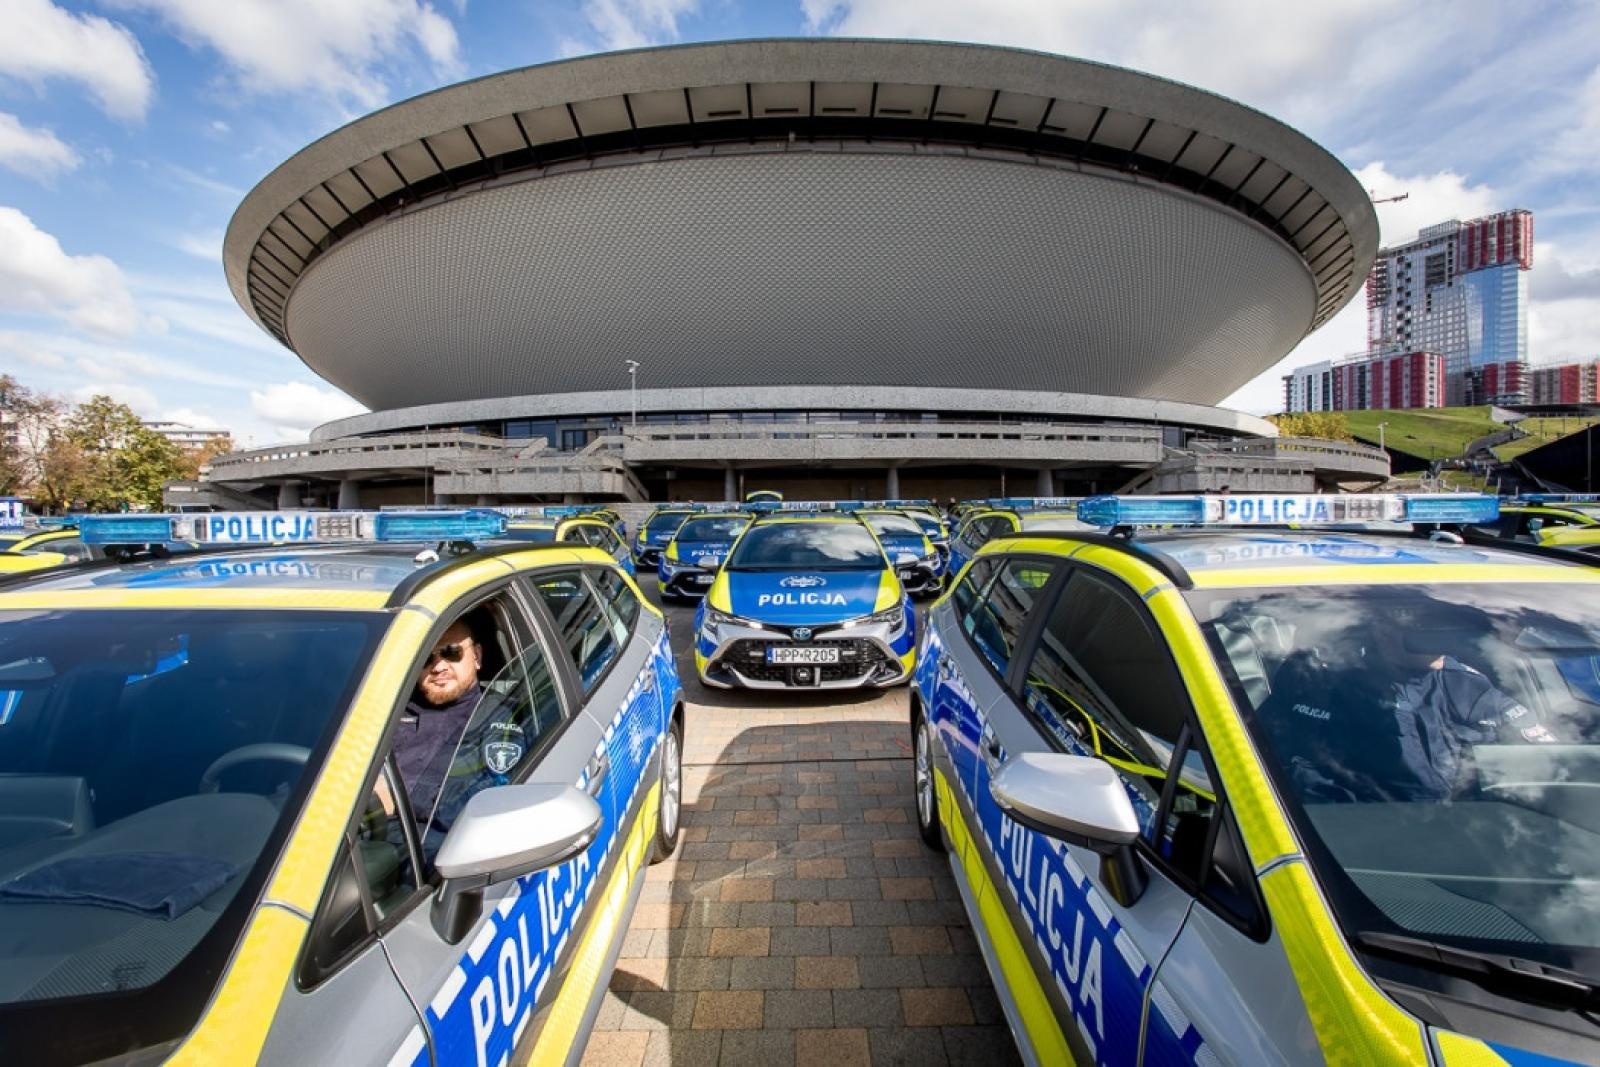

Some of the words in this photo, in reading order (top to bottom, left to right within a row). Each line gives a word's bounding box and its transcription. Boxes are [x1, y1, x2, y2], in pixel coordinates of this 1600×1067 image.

[1226, 497, 1329, 522] POLICJA
[210, 514, 313, 541] POLICJA
[691, 549, 729, 557] POLICJ
[758, 592, 847, 607] POLICJA
[775, 649, 799, 662] HPP
[804, 649, 836, 662] R205
[1292, 703, 1331, 720] POLICJA
[1000, 812, 1104, 1041] POLICJA
[470, 850, 590, 1067] POLICJA
